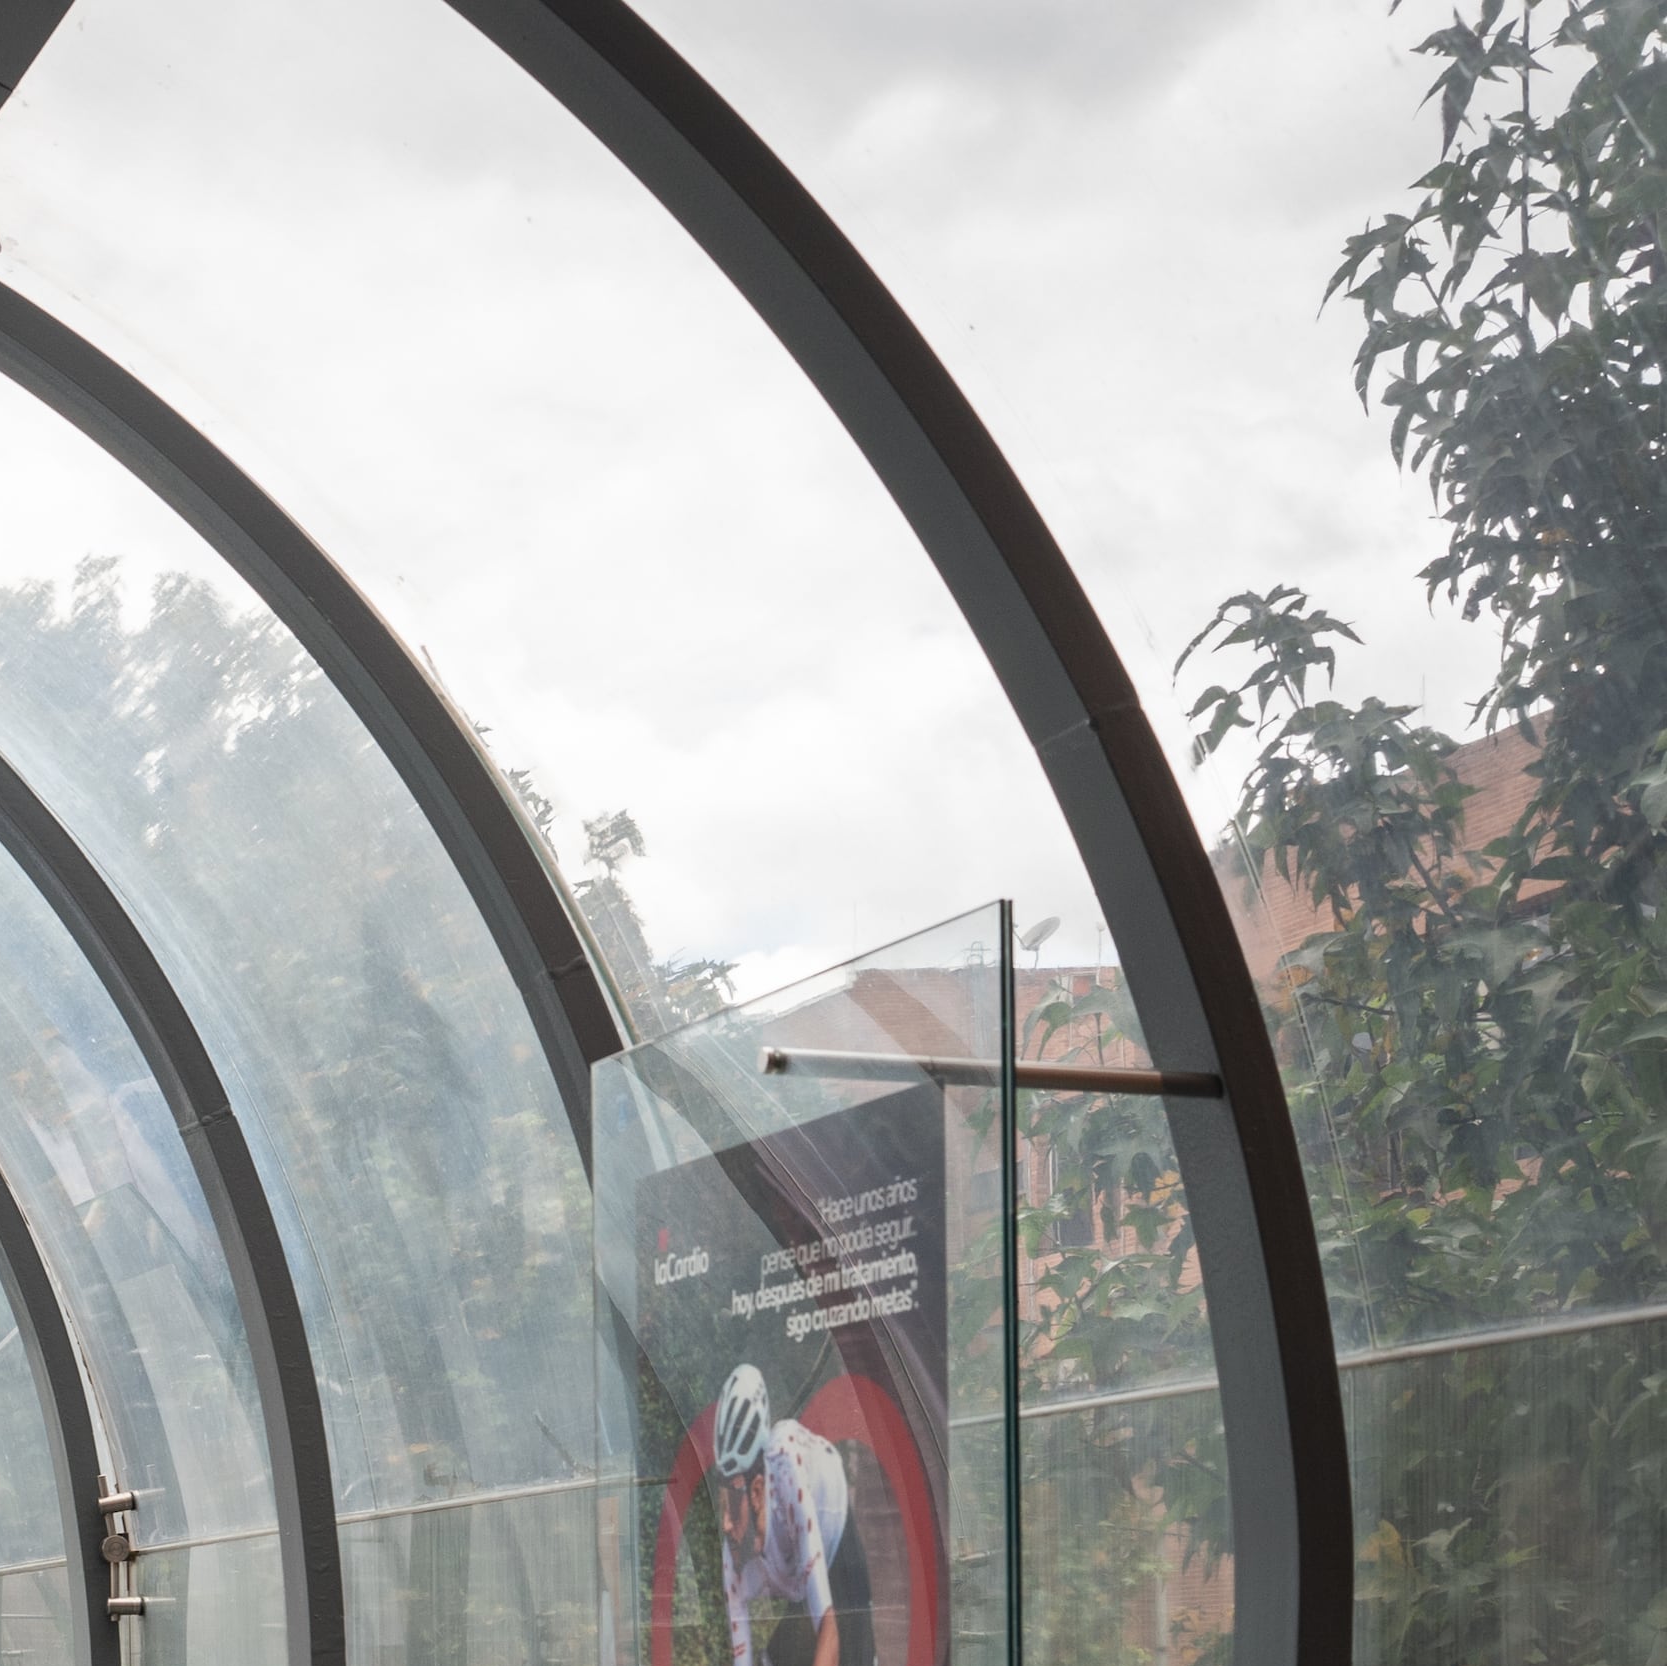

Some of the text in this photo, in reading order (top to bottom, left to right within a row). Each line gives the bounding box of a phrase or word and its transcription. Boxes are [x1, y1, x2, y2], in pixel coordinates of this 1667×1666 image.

[854, 1187, 886, 1216] unos
[886, 1175, 917, 1208] años
[796, 1240, 821, 1277] que
[822, 1235, 838, 1260] no
[756, 1273, 805, 1313] después
[807, 1269, 823, 1299] de
[824, 1263, 840, 1294] mi
[786, 1308, 811, 1342] sigo
[812, 1293, 869, 1330] cruzando
